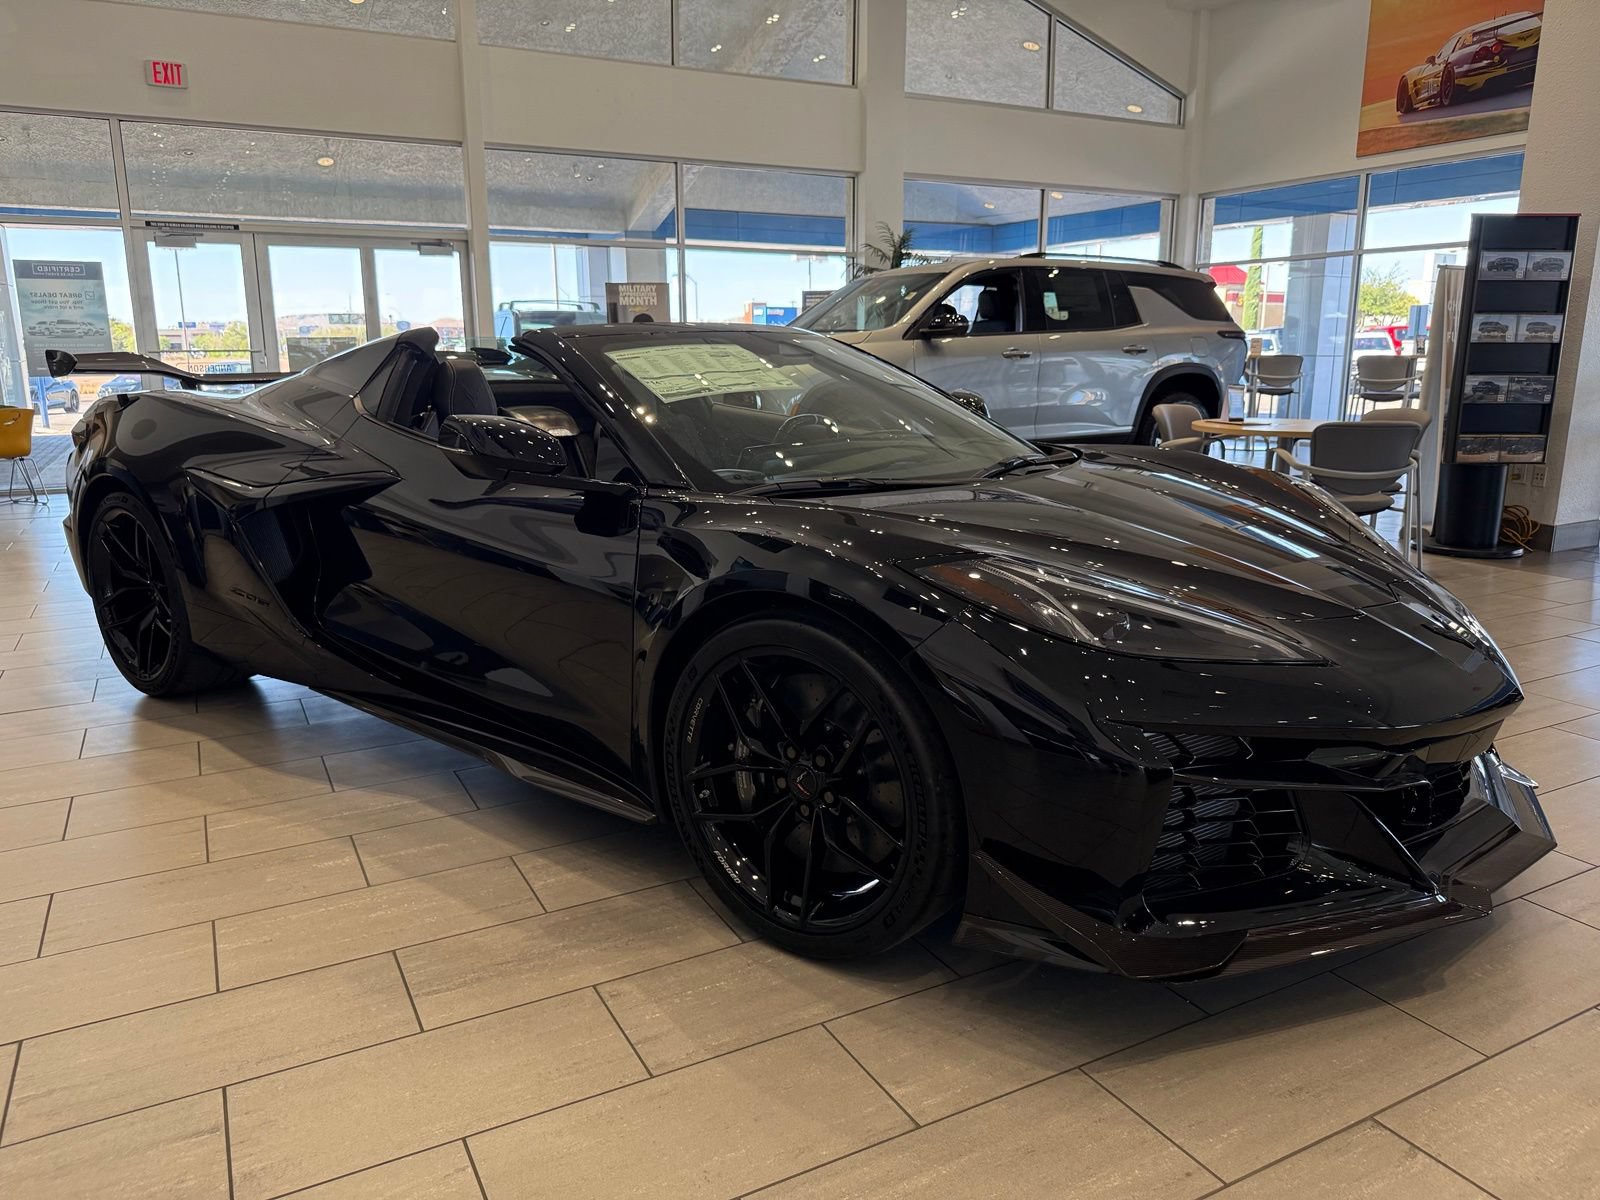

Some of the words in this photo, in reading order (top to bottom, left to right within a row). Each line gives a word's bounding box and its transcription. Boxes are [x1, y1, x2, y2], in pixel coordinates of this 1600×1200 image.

[152, 61, 182, 86] EXIT
[618, 284, 657, 292] MILITARY
[619, 296, 657, 306] MONTH
[686, 697, 704, 744] CORVETTE
[713, 850, 741, 884] FORGED
